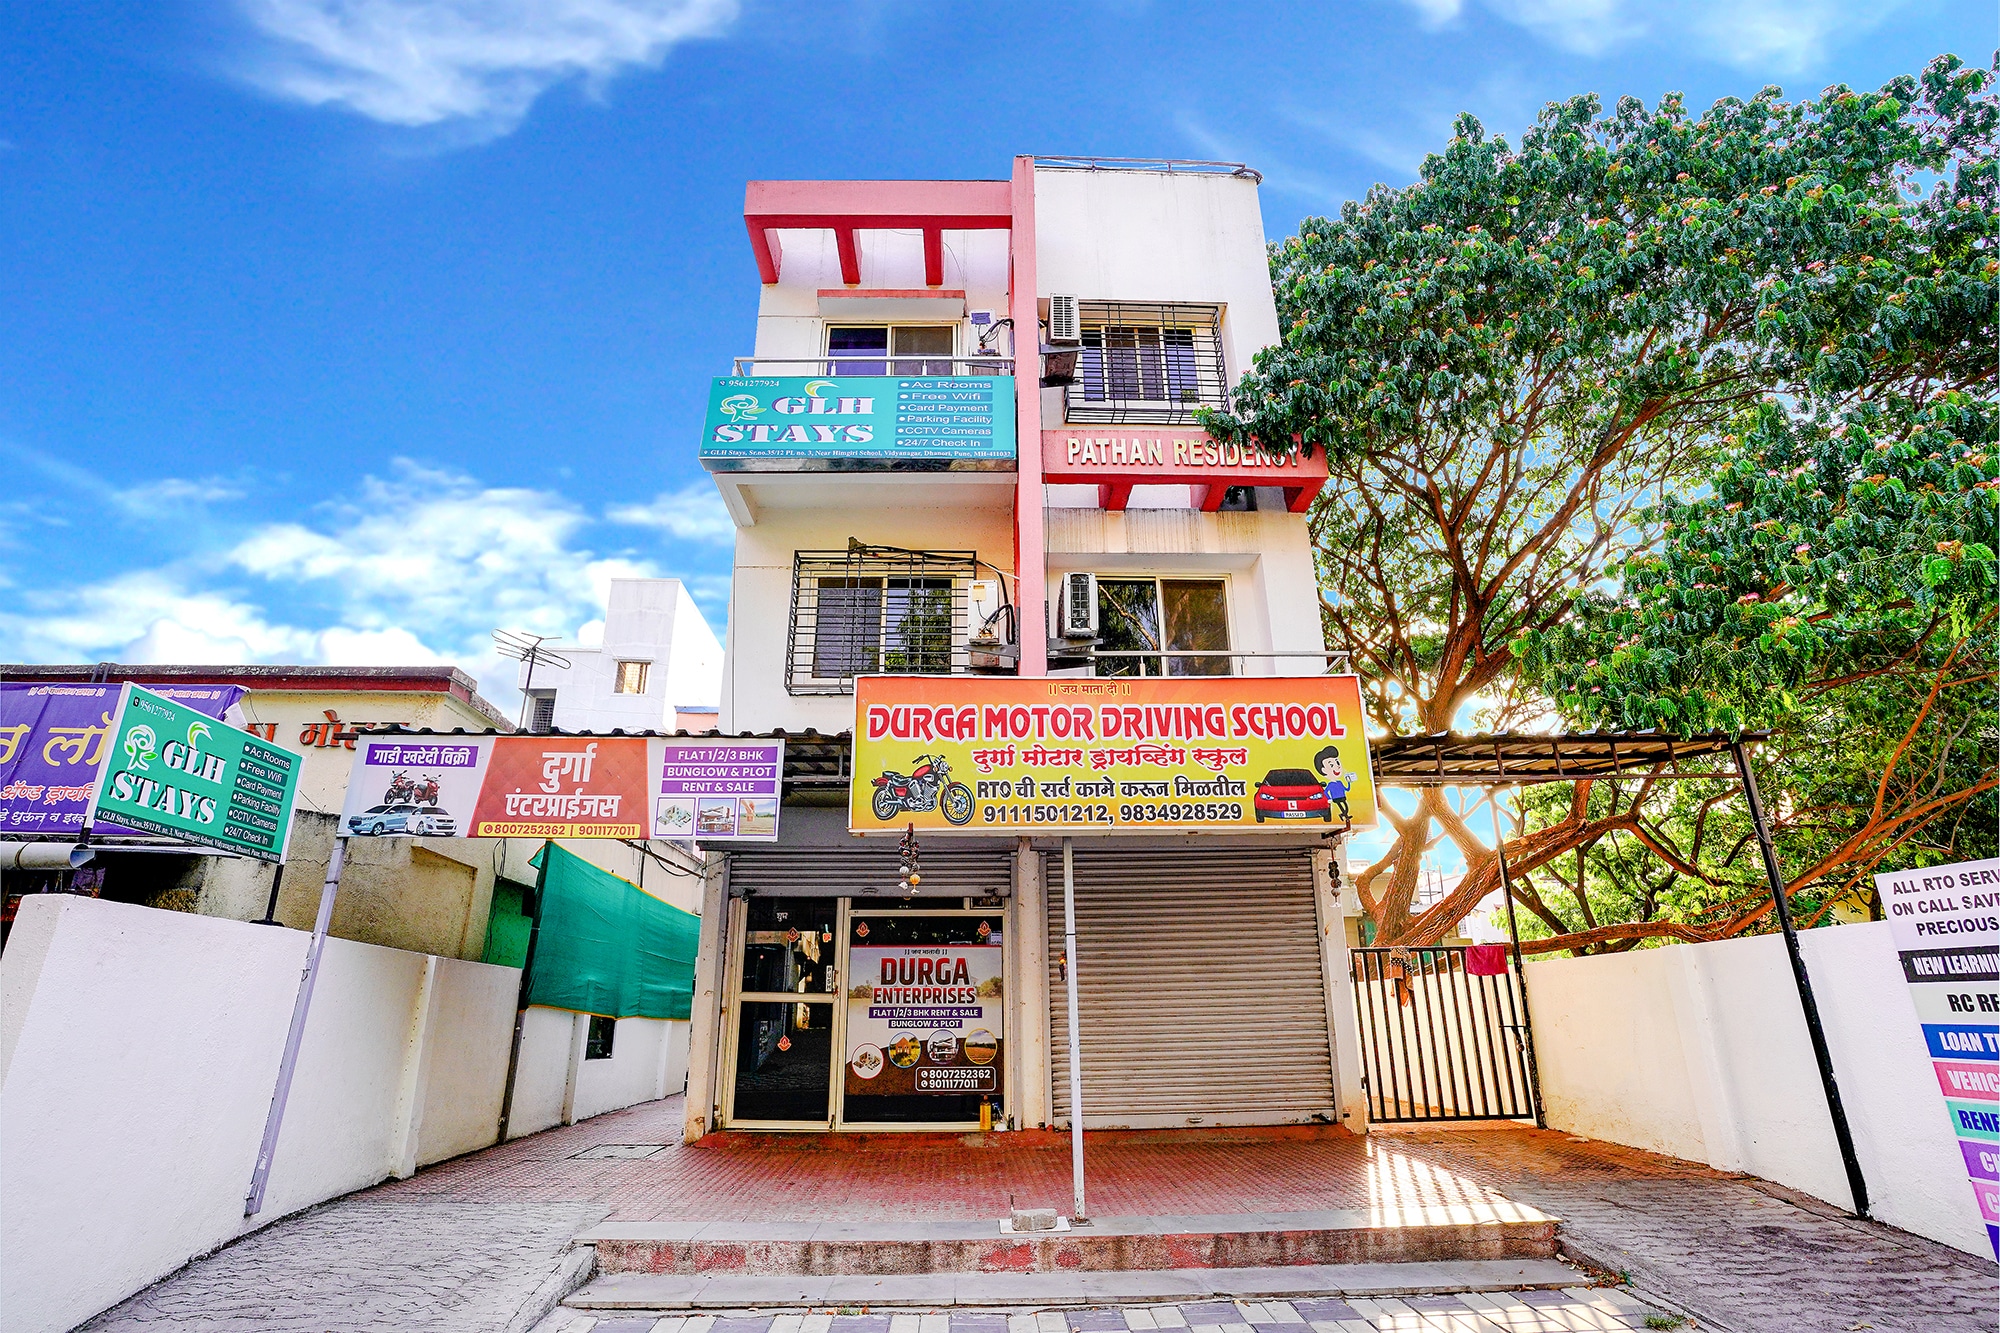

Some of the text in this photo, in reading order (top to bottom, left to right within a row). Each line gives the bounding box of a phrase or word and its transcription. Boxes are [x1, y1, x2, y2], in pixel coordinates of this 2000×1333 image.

[772, 397, 876, 414] GLH
[912, 392, 980, 400] Free Wifi
[908, 404, 988, 413] Card Payment
[907, 415, 992, 424] Parking Facility
[712, 424, 874, 443] STAYS
[905, 427, 991, 435] CCTV Cameras
[1066, 438, 1164, 465] PATHAN
[1060, 684, 1078, 694] जय
[1080, 684, 1103, 694] माता
[1106, 682, 1117, 696] दी
[140, 699, 176, 722] 9561277924
[868, 706, 1346, 742] DURGA MOTOR DRIVING SCHOOL
[162, 740, 227, 784] GLH
[250, 746, 290, 769] Ac Rooms
[374, 746, 471, 766] गाडी खरेदी विक्री
[678, 748, 763, 762] FLAT 1/2/3 BHK
[973, 744, 1015, 772] दुर्गा
[1022, 744, 1083, 767] मोटार
[246, 762, 283, 783] Free Wifi
[539, 743, 598, 793] दुर्गा
[667, 767, 772, 777] BUNGLOW & PLOT
[240, 777, 282, 800] Card Payment
[682, 782, 754, 792] RENT & SALE
[977, 775, 1246, 798] RTO ची सर्व कामे करून मिळतील
[109, 770, 217, 824] STAYS
[236, 793, 280, 817] Parking Facility
[505, 788, 622, 820] एंटरप्राईजस
[102, 811, 116, 820] GLH
[232, 809, 277, 831] CCTV Cameras
[984, 803, 1242, 825] 9111501212, 9834928529
[228, 826, 269, 845] 24/7 Check In
[494, 824, 565, 835] 8007252362
[579, 825, 635, 836] 9011177011
[1893, 880, 1920, 895] ALL
[1923, 875, 1955, 891] RTO
[1892, 902, 1914, 916] ON
[1918, 898, 1959, 914] CALL
[1916, 916, 1999, 936] PRECIOUS
[880, 958, 970, 986] DURGA
[1912, 957, 1946, 975] NEW
[874, 988, 976, 1004] ENTERPRISES
[1947, 994, 1975, 1012] RC
[893, 1008, 912, 1018] 1/2/3
[891, 1020, 960, 1028] BUNGLOW & PLOT
[1938, 1032, 1984, 1052] LOAN
[929, 1070, 990, 1079] 8007252362
[929, 1080, 978, 1088] 9011177011
